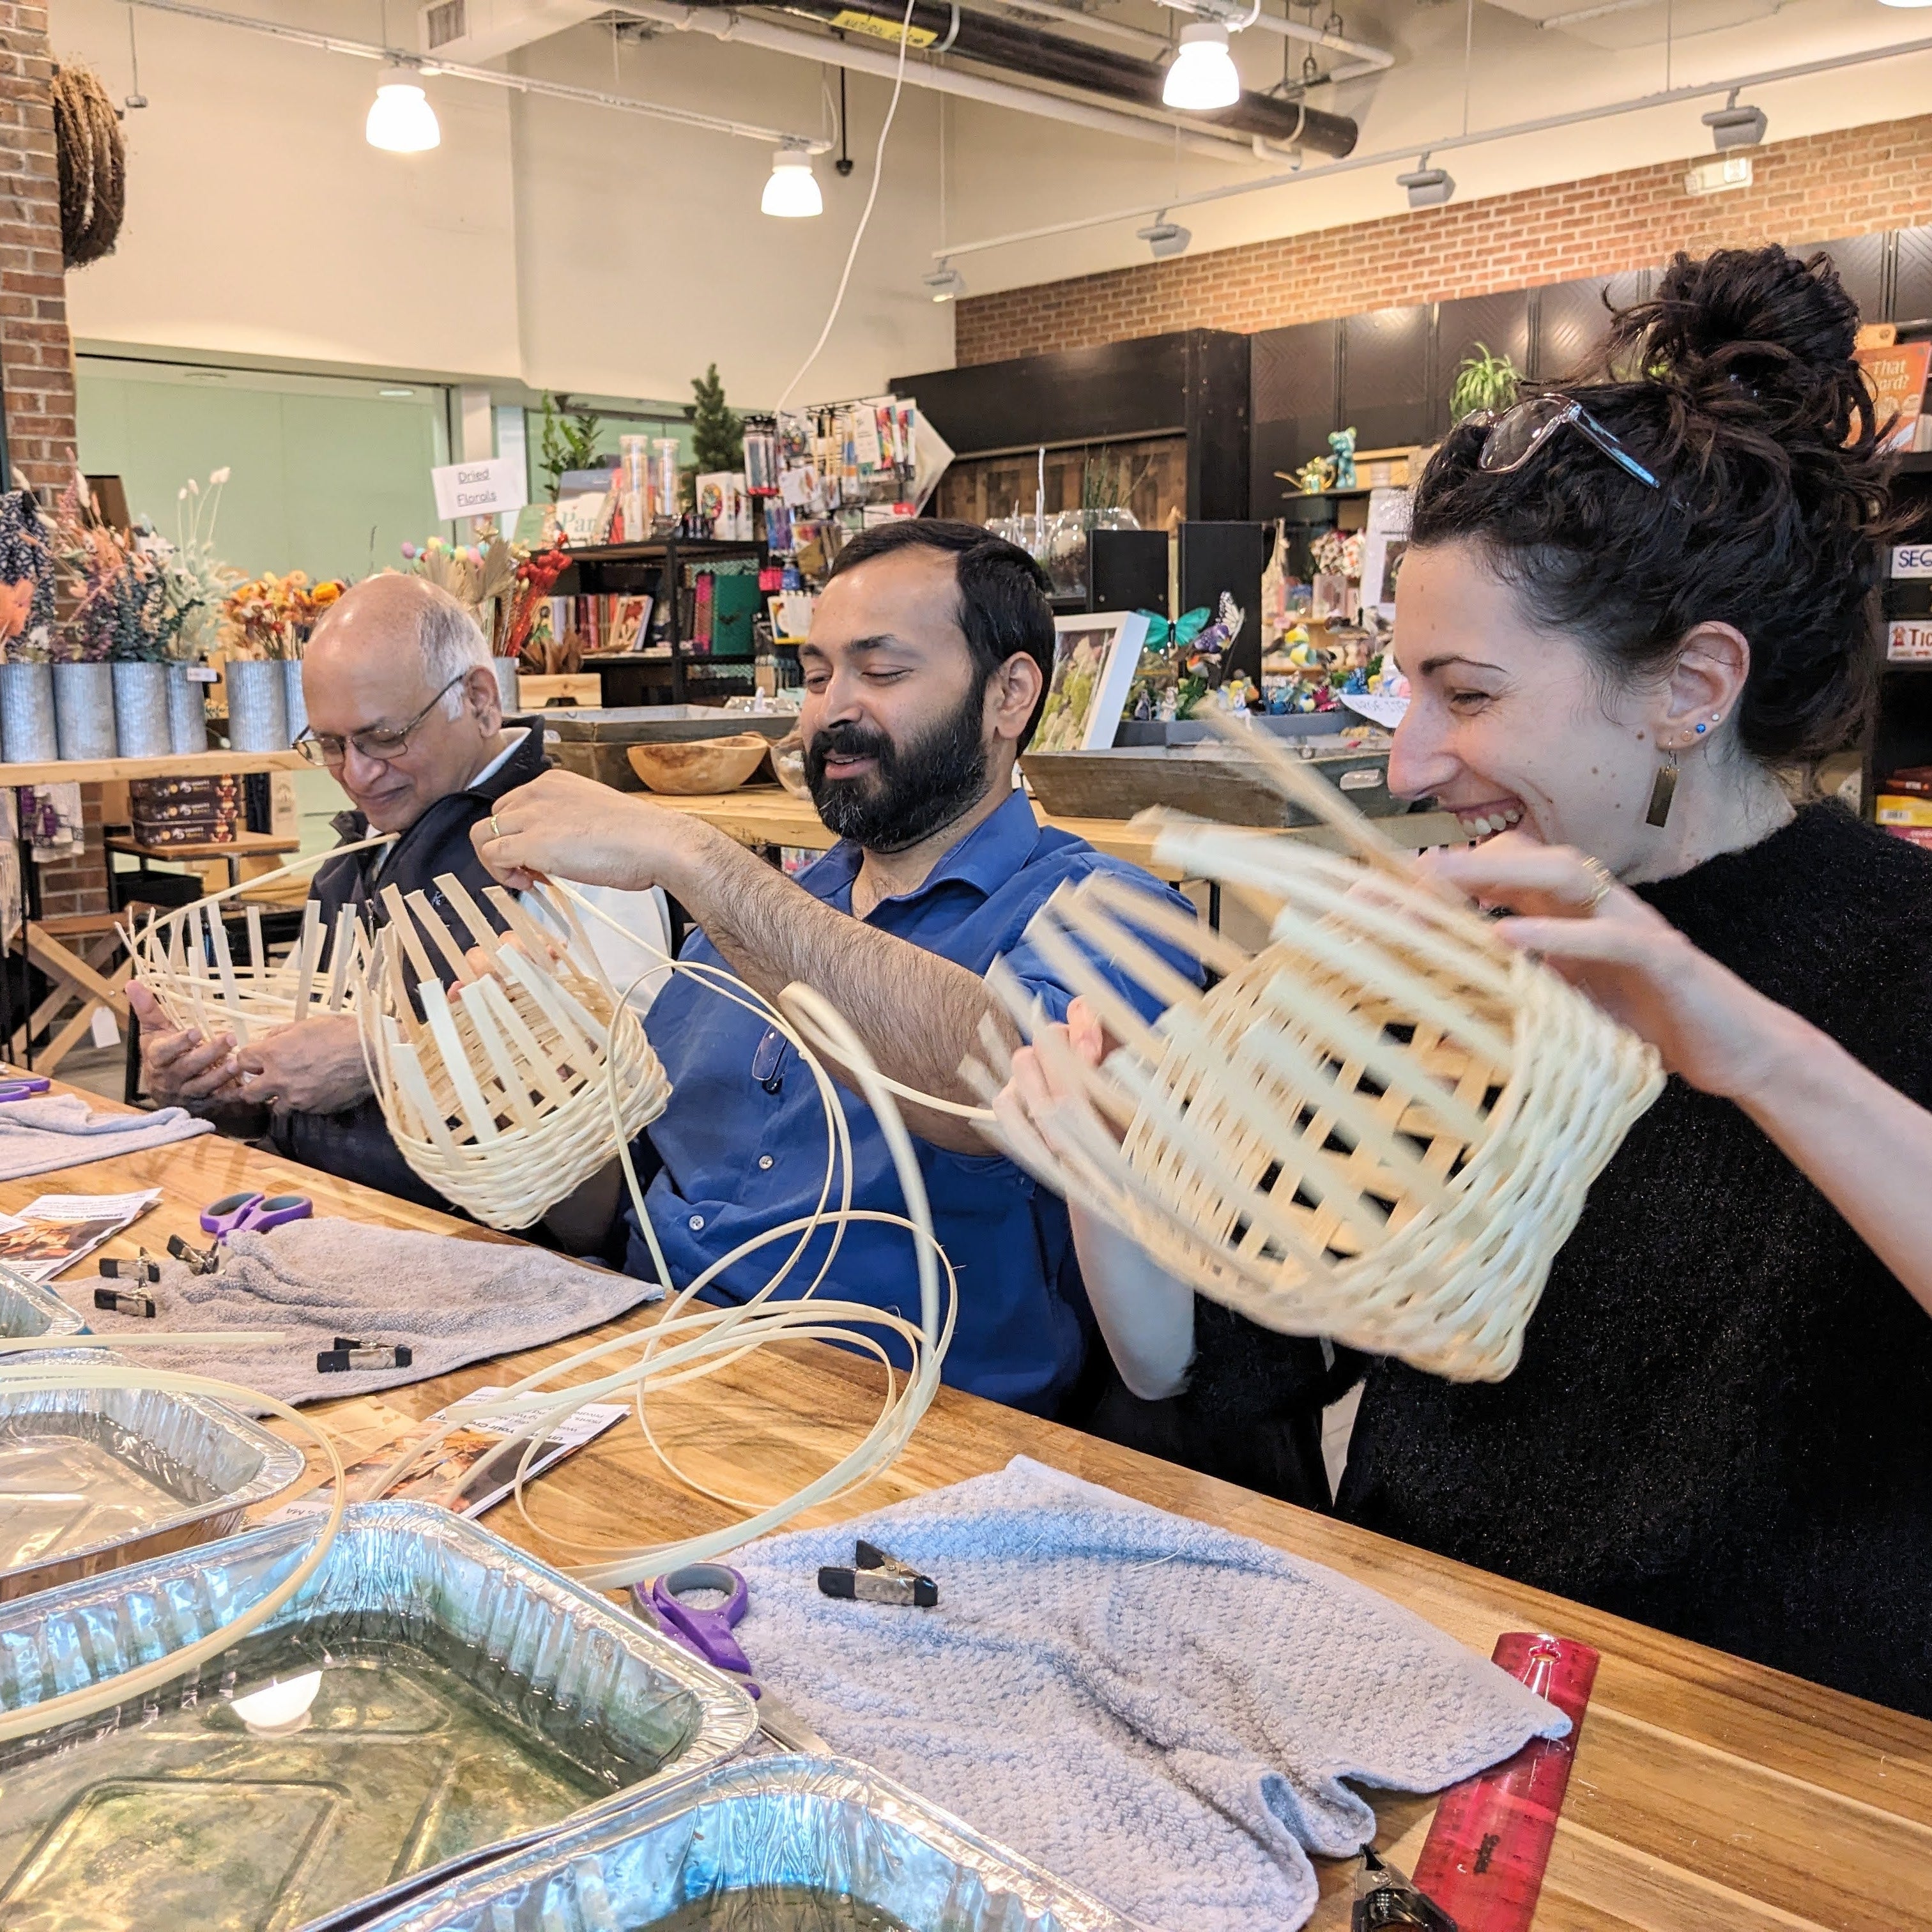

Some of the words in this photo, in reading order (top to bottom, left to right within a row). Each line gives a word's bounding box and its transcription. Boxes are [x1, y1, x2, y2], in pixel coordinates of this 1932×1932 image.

[1873, 359, 1906, 374] That
[458, 469, 490, 484] Dried
[457, 490, 497, 507] Florals
[489, 1425, 515, 1434] Your
